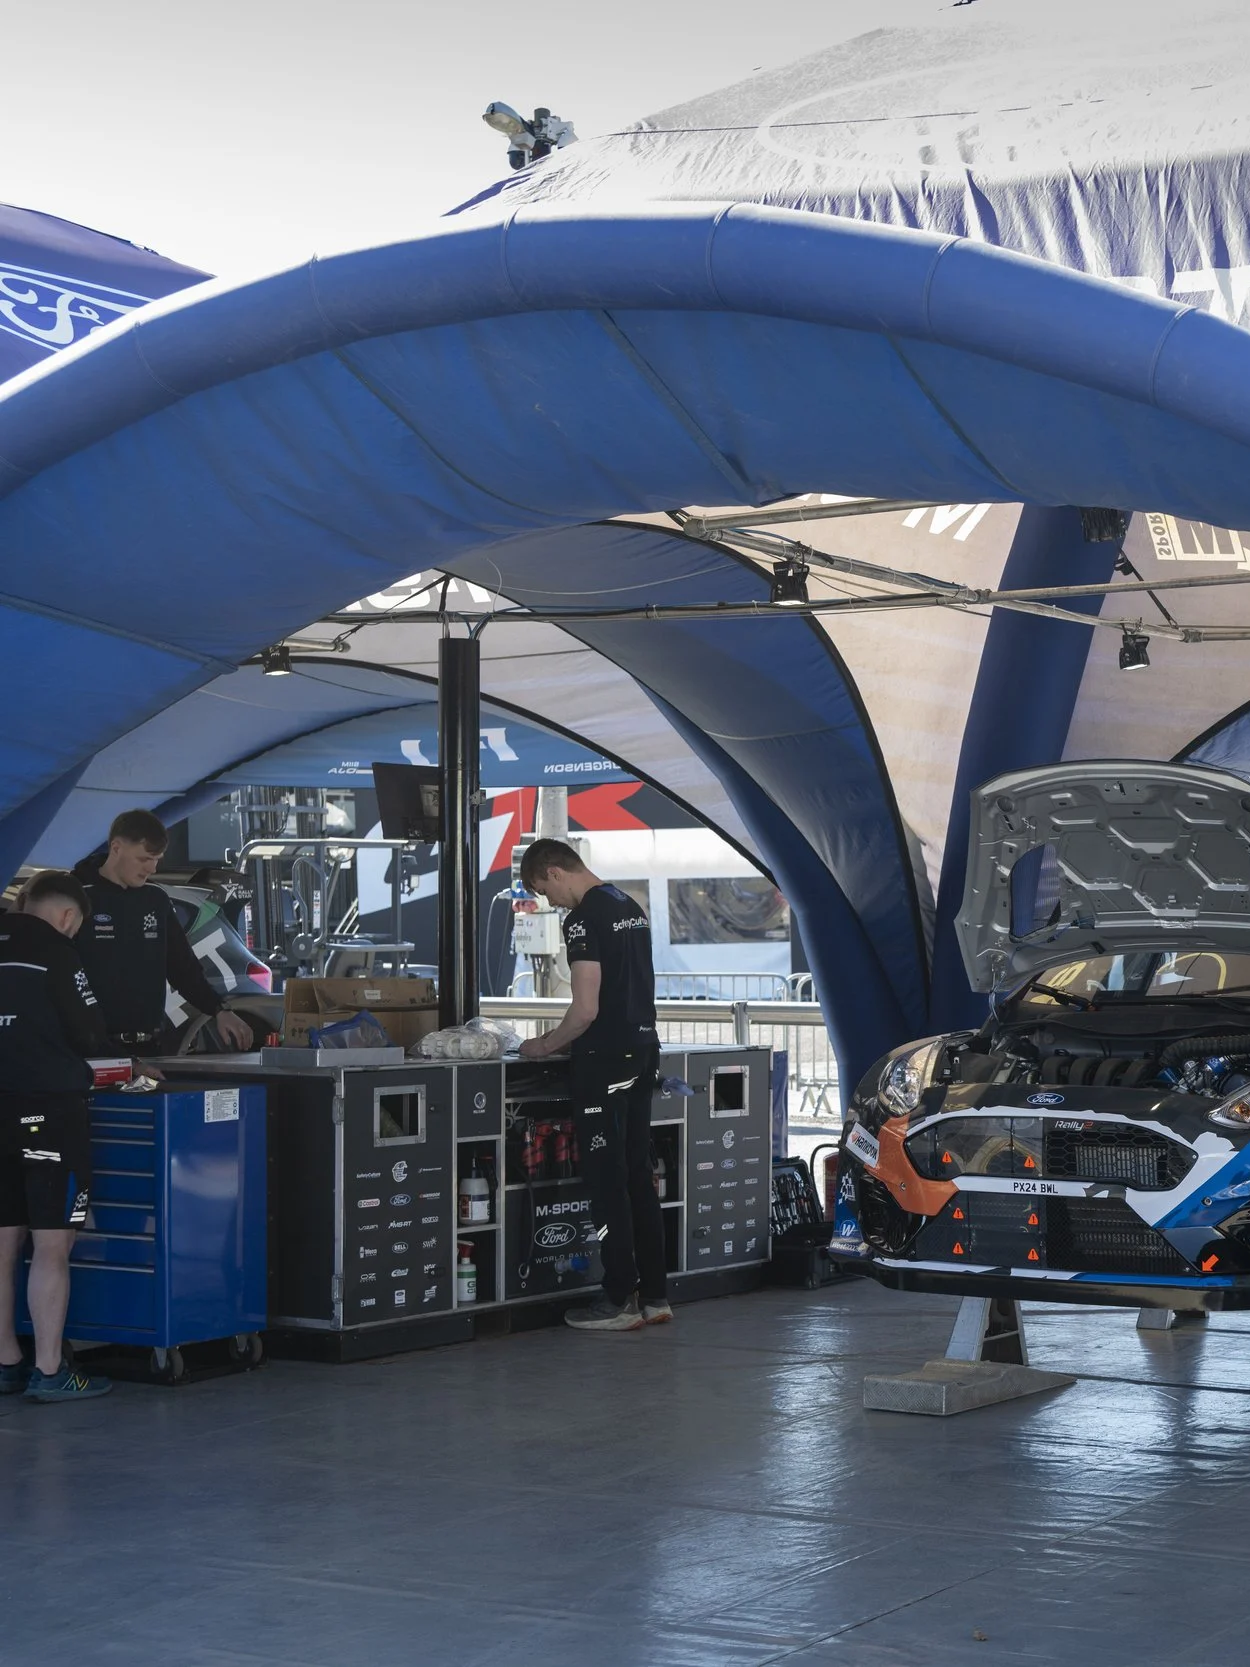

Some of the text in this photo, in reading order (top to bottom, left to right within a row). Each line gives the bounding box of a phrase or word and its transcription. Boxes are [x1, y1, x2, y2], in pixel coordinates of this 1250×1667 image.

[1030, 1093, 1059, 1105] Ford
[1055, 1120, 1094, 1131] Rally2
[1013, 1182, 1059, 1194] PX24 BWL
[535, 1200, 591, 1217] M-SPOR
[541, 1225, 571, 1246] Ford
